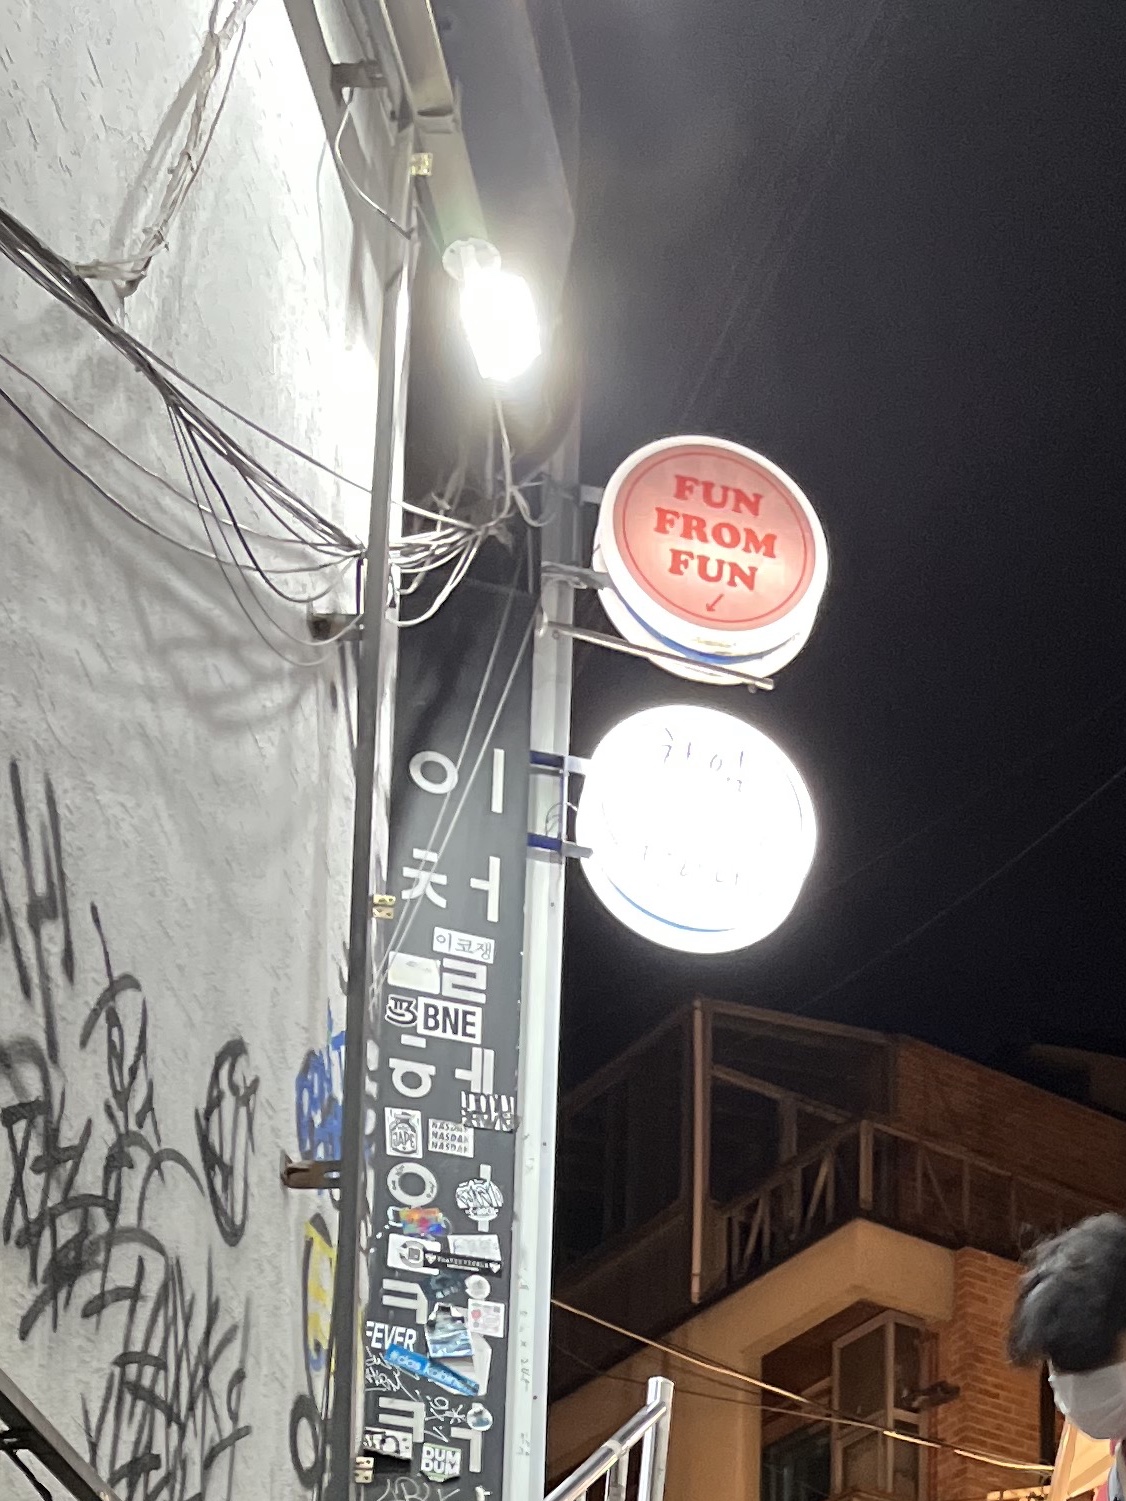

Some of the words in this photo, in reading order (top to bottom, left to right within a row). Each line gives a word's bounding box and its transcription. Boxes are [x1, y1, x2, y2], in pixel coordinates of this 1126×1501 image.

[673, 474, 763, 517] FUN
[653, 506, 777, 559] FROM
[667, 548, 759, 591] FUN
[423, 1002, 476, 1039] BNE
[422, 1458, 460, 1476] DUM
[424, 1447, 461, 1463] DUM
